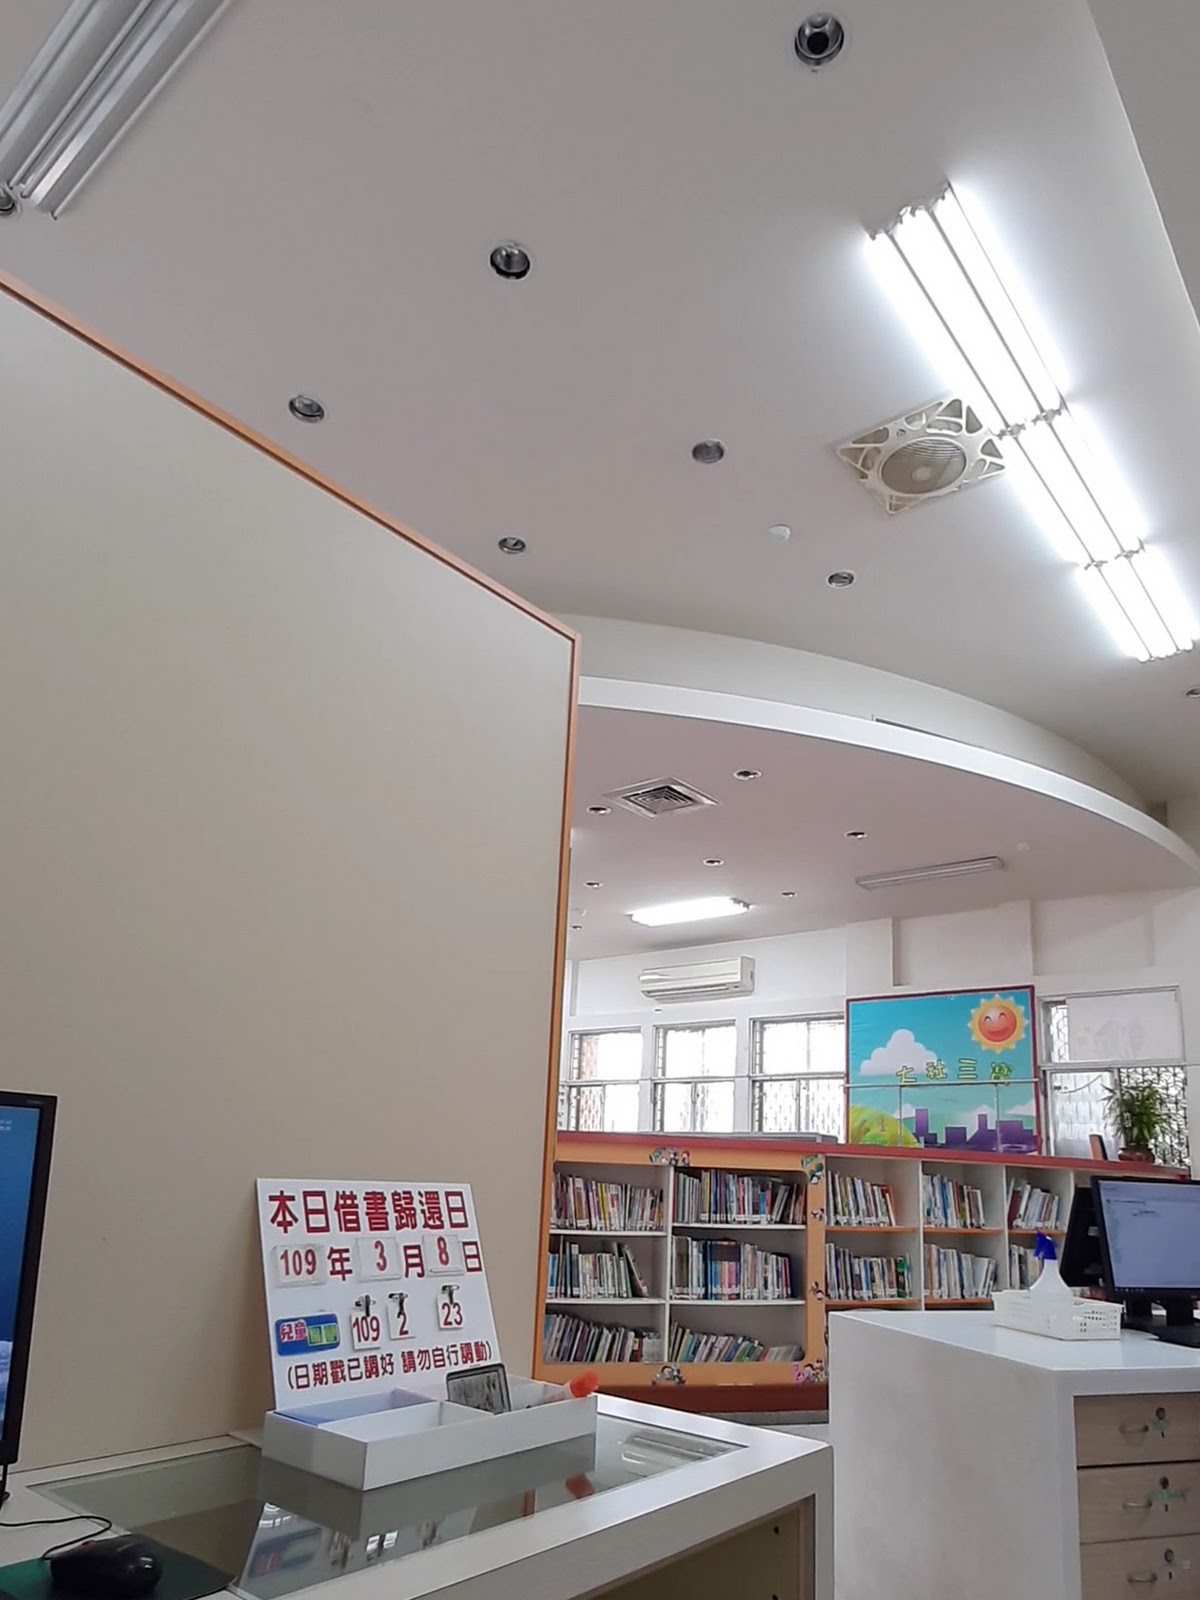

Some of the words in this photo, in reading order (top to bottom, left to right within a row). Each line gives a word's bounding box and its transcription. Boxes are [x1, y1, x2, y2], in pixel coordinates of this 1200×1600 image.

[268, 1190, 469, 1233] 本日借書歸還日
[280, 1248, 317, 1276] 109
[352, 1316, 380, 1343] 109
[398, 1312, 410, 1336] 2
[441, 1302, 463, 1327] 23
